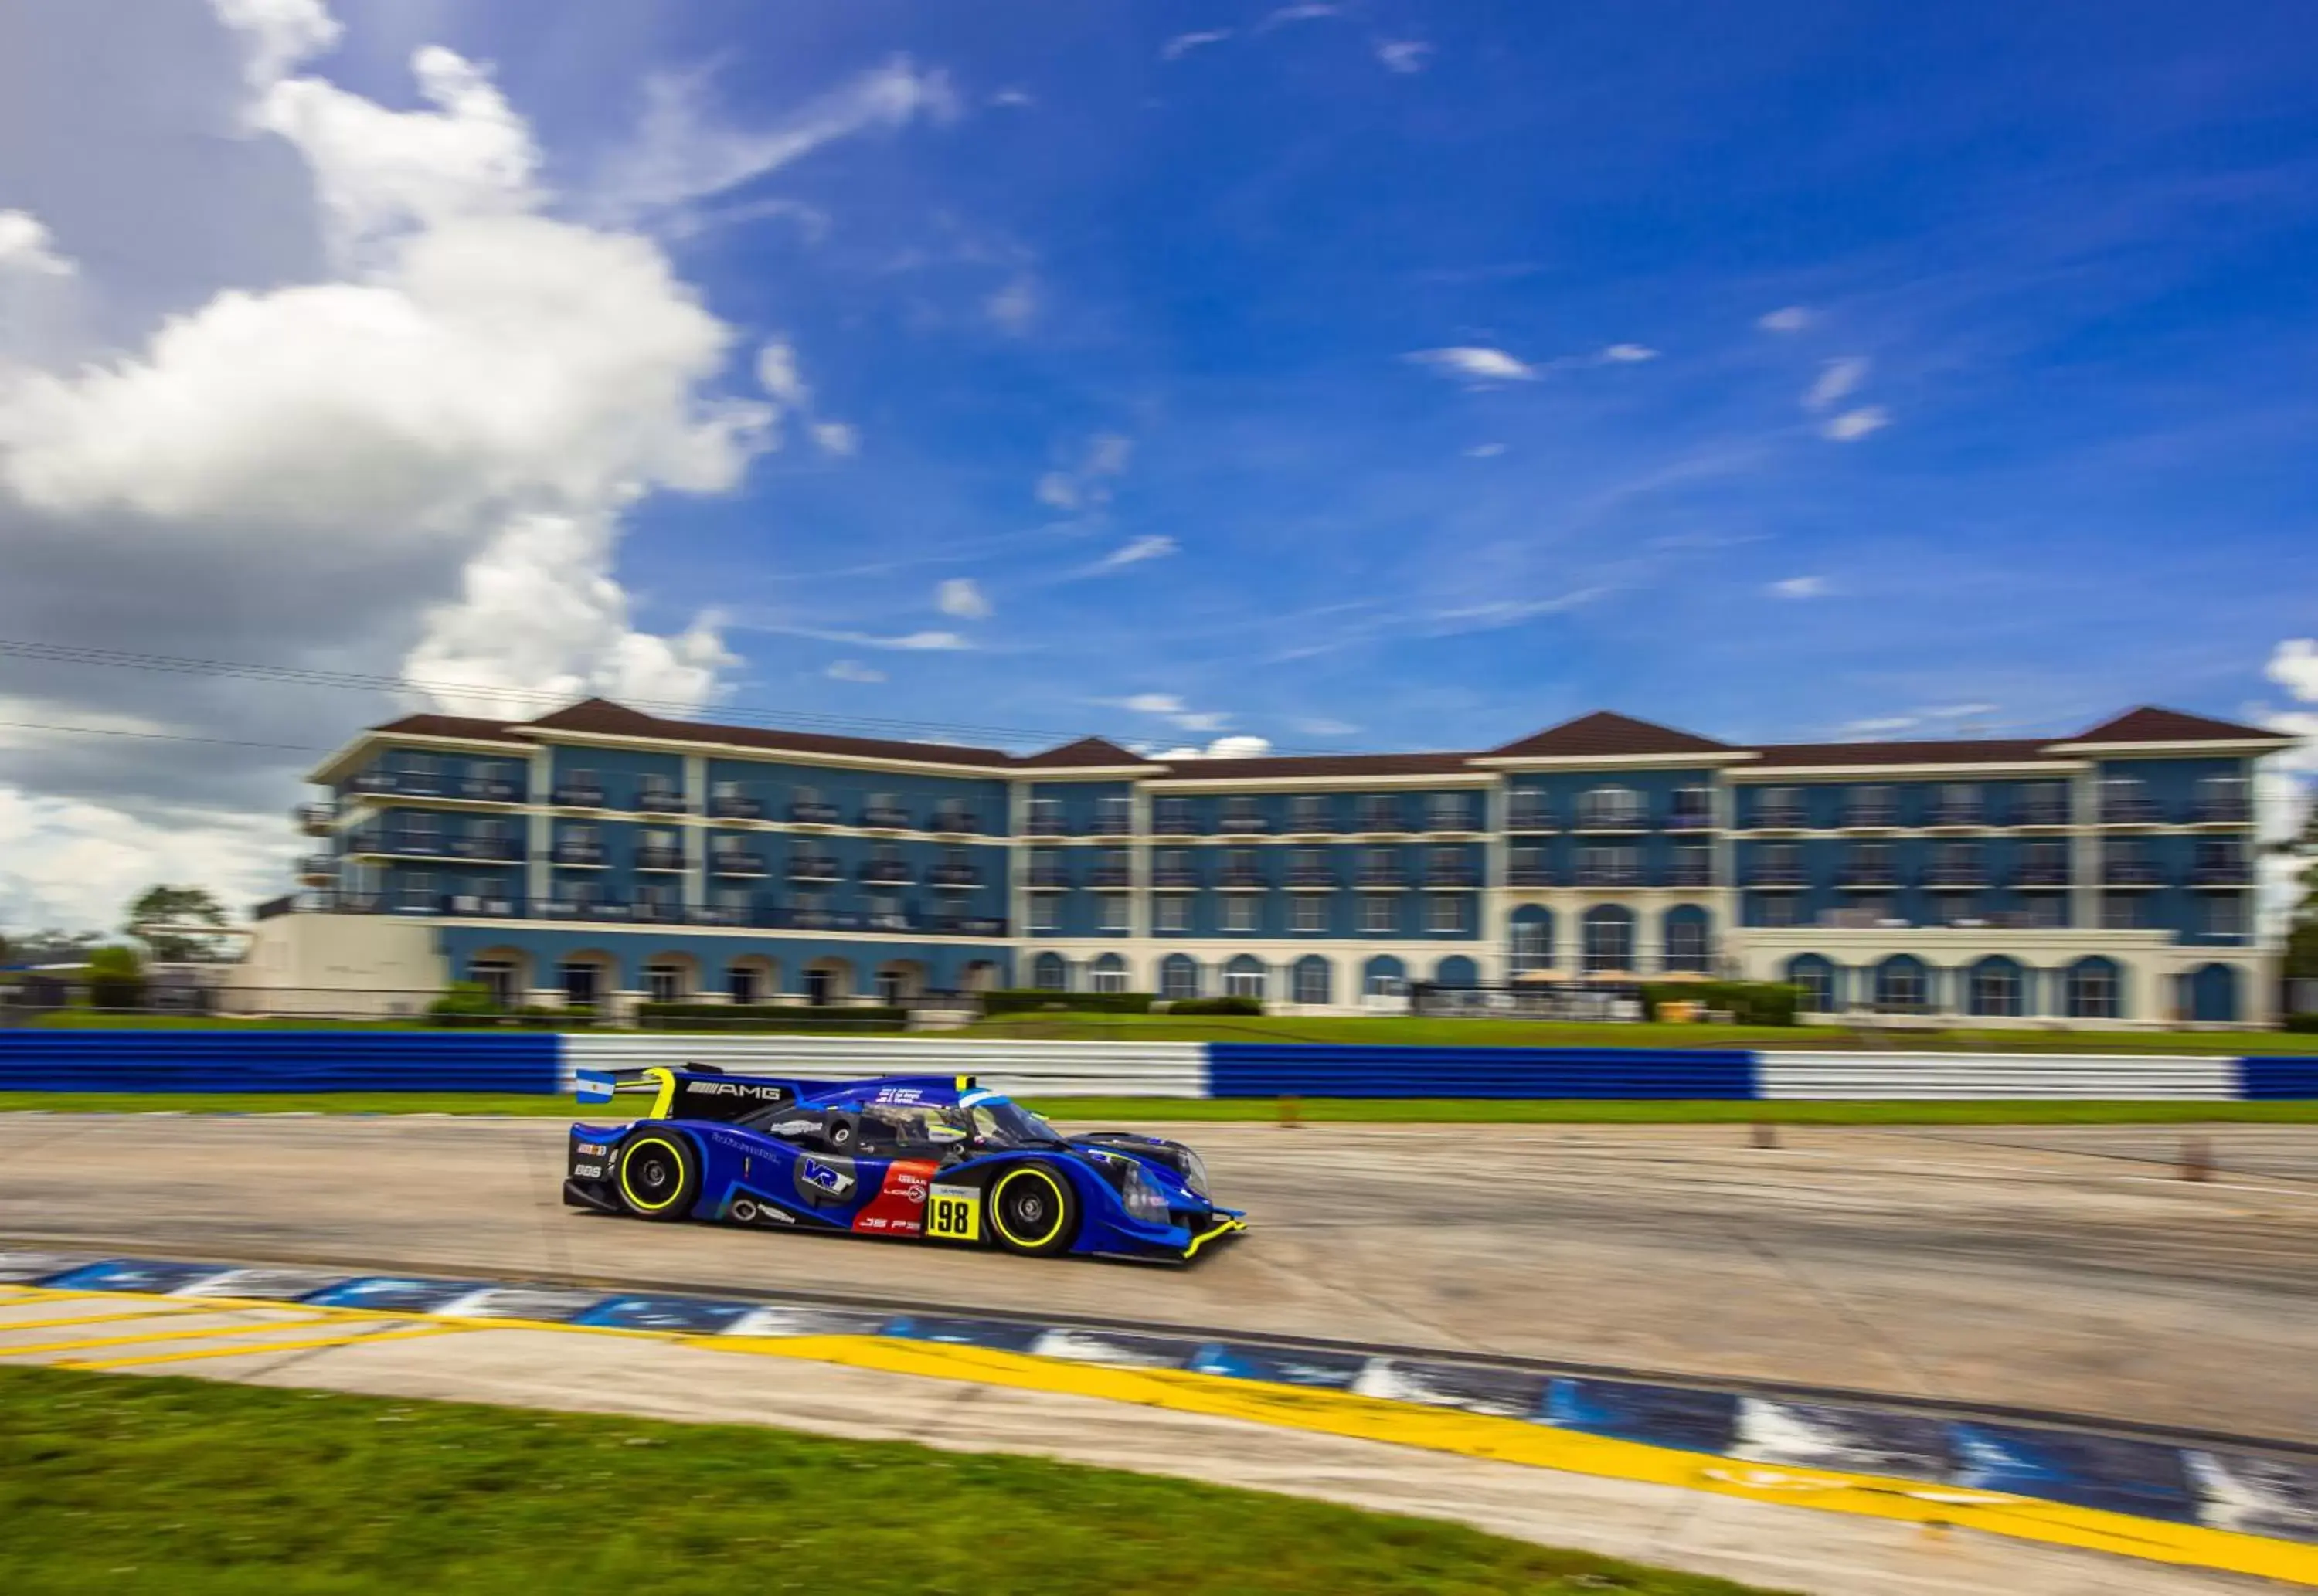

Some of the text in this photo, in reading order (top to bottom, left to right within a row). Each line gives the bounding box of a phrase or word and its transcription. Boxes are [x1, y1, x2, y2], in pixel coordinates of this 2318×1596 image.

[716, 1083, 780, 1101] AMG
[804, 1158, 855, 1192] VRT
[930, 1198, 969, 1234] 198
